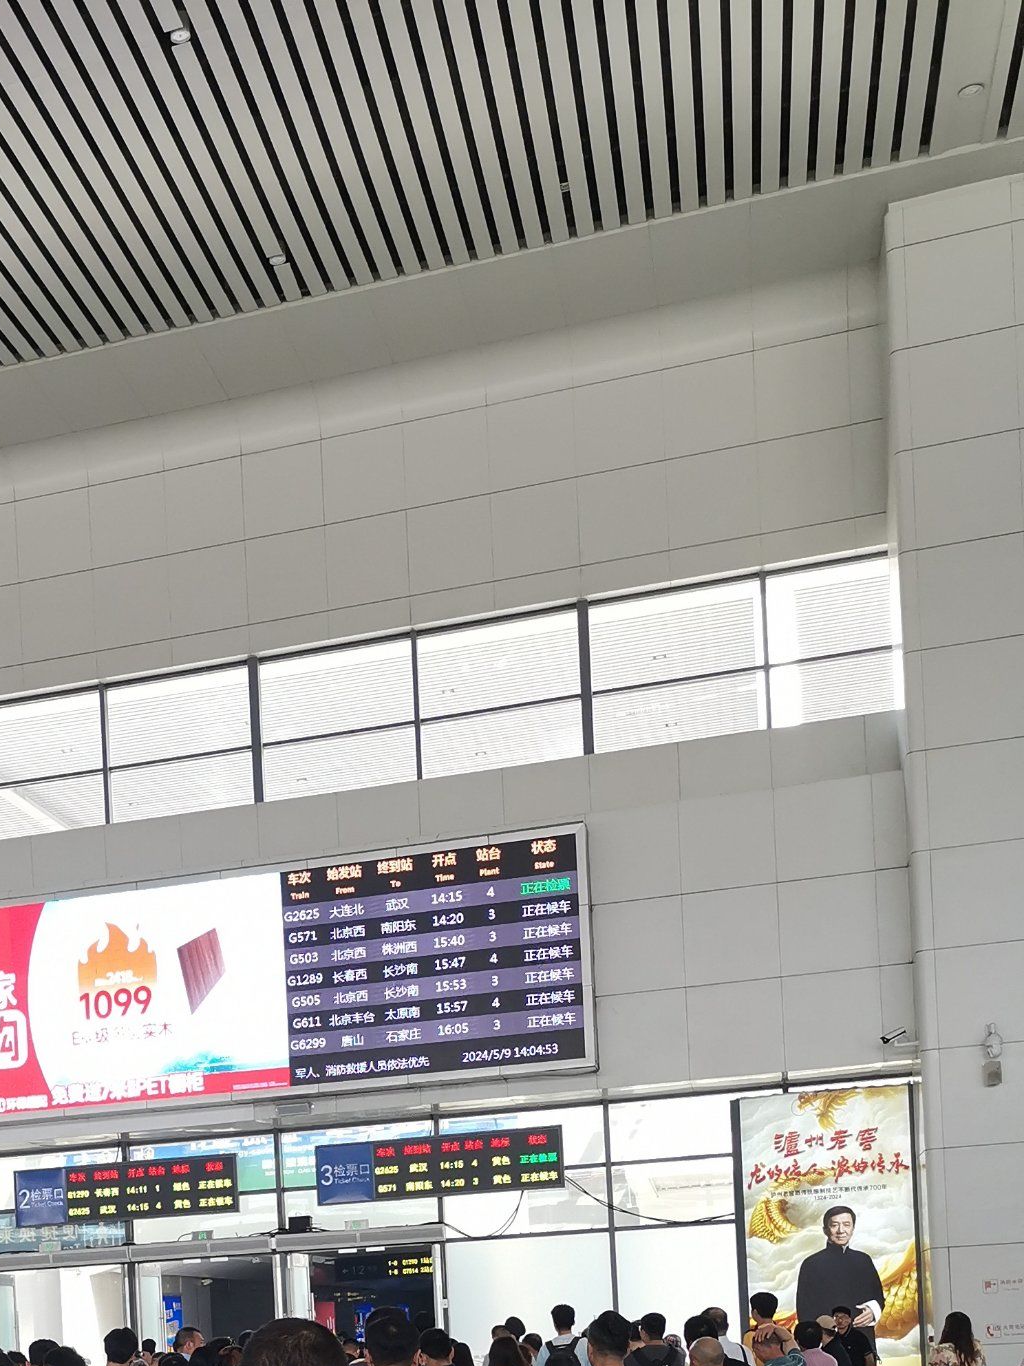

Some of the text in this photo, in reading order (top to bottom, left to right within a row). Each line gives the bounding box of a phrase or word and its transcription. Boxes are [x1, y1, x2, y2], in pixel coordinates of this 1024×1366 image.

[288, 839, 556, 886] 车次 始发站 终到站 开点 站台 状态
[290, 891, 309, 900] Train
[335, 886, 355, 894] From
[435, 874, 455, 882] Time
[479, 867, 500, 876] Plant
[534, 861, 554, 869] State
[284, 877, 570, 922] G2625 大连北 武汉 14:15 4 正在检票
[288, 900, 571, 943] G571 北京西 南阳东 14:20 3 正在候车
[290, 922, 573, 965] G503 北京西 株洲西 15:40 3 正在候车
[287, 945, 574, 986] G1289 长春西 长沙南 15:47 4 正在候车
[80, 986, 151, 1021] 1099
[291, 967, 575, 1007] G505 北京西 长沙南 15:53 3 正在候车
[292, 989, 575, 1029] G611 北京丰台 太原南 15:57 4 正在候车
[290, 1011, 576, 1050] G6299 唐山 石家庄 16:05 3 正在候车
[295, 1056, 429, 1080] 军人、消防救援人员依法优先
[462, 1043, 558, 1062] 2024/5/9 14:04:53
[774, 1128, 878, 1157] 泸州老窖
[321, 1165, 333, 1186] 3
[334, 1163, 370, 1176] 检票口
[440, 1178, 465, 1188] 14:20
[473, 1177, 479, 1185] 3
[471, 1159, 478, 1167] 4
[18, 1187, 63, 1208] 2 检票口
